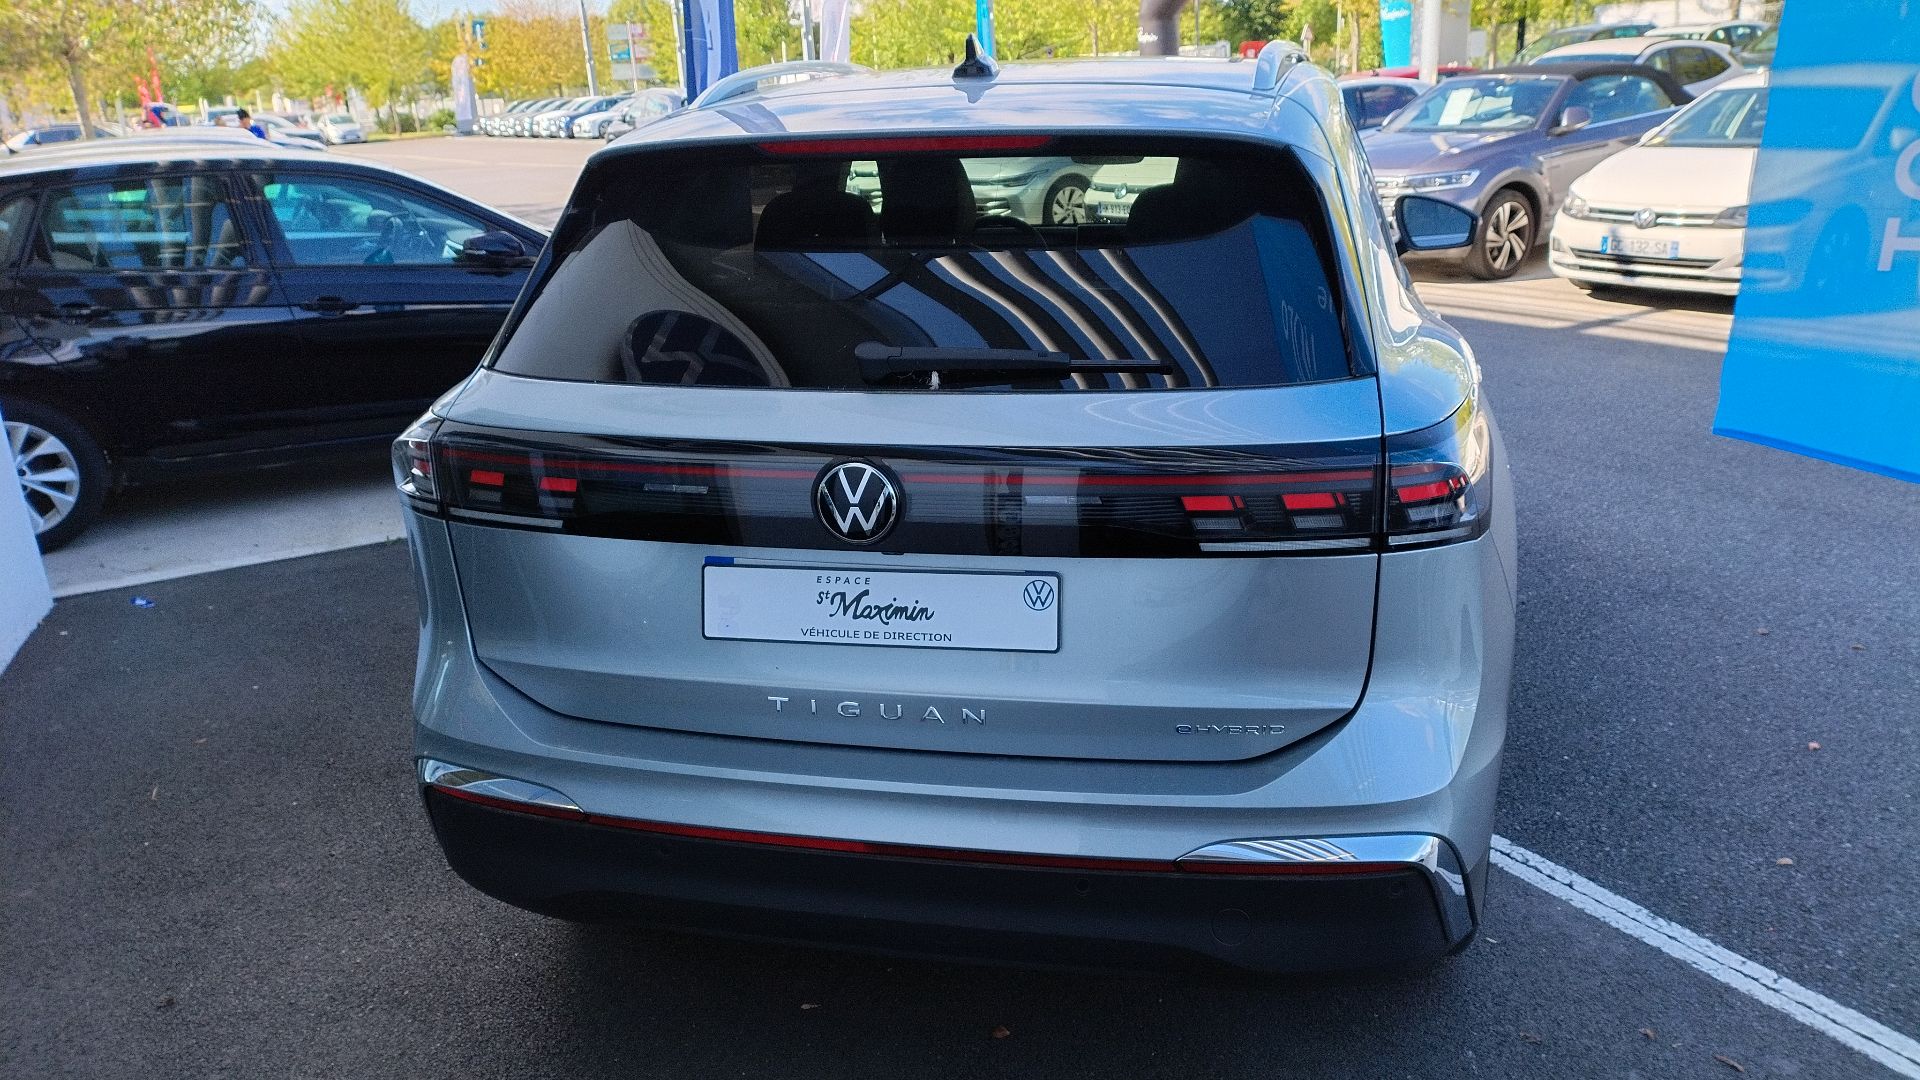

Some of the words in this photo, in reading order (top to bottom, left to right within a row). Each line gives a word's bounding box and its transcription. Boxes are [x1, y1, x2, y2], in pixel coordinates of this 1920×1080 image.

[816, 575, 871, 585] ESPACE
[829, 589, 935, 626] Maximin
[801, 627, 860, 639] VÉHICULE
[863, 630, 880, 640] DE
[883, 631, 952, 642] DIRECTION
[767, 696, 987, 726] TIGUAN
